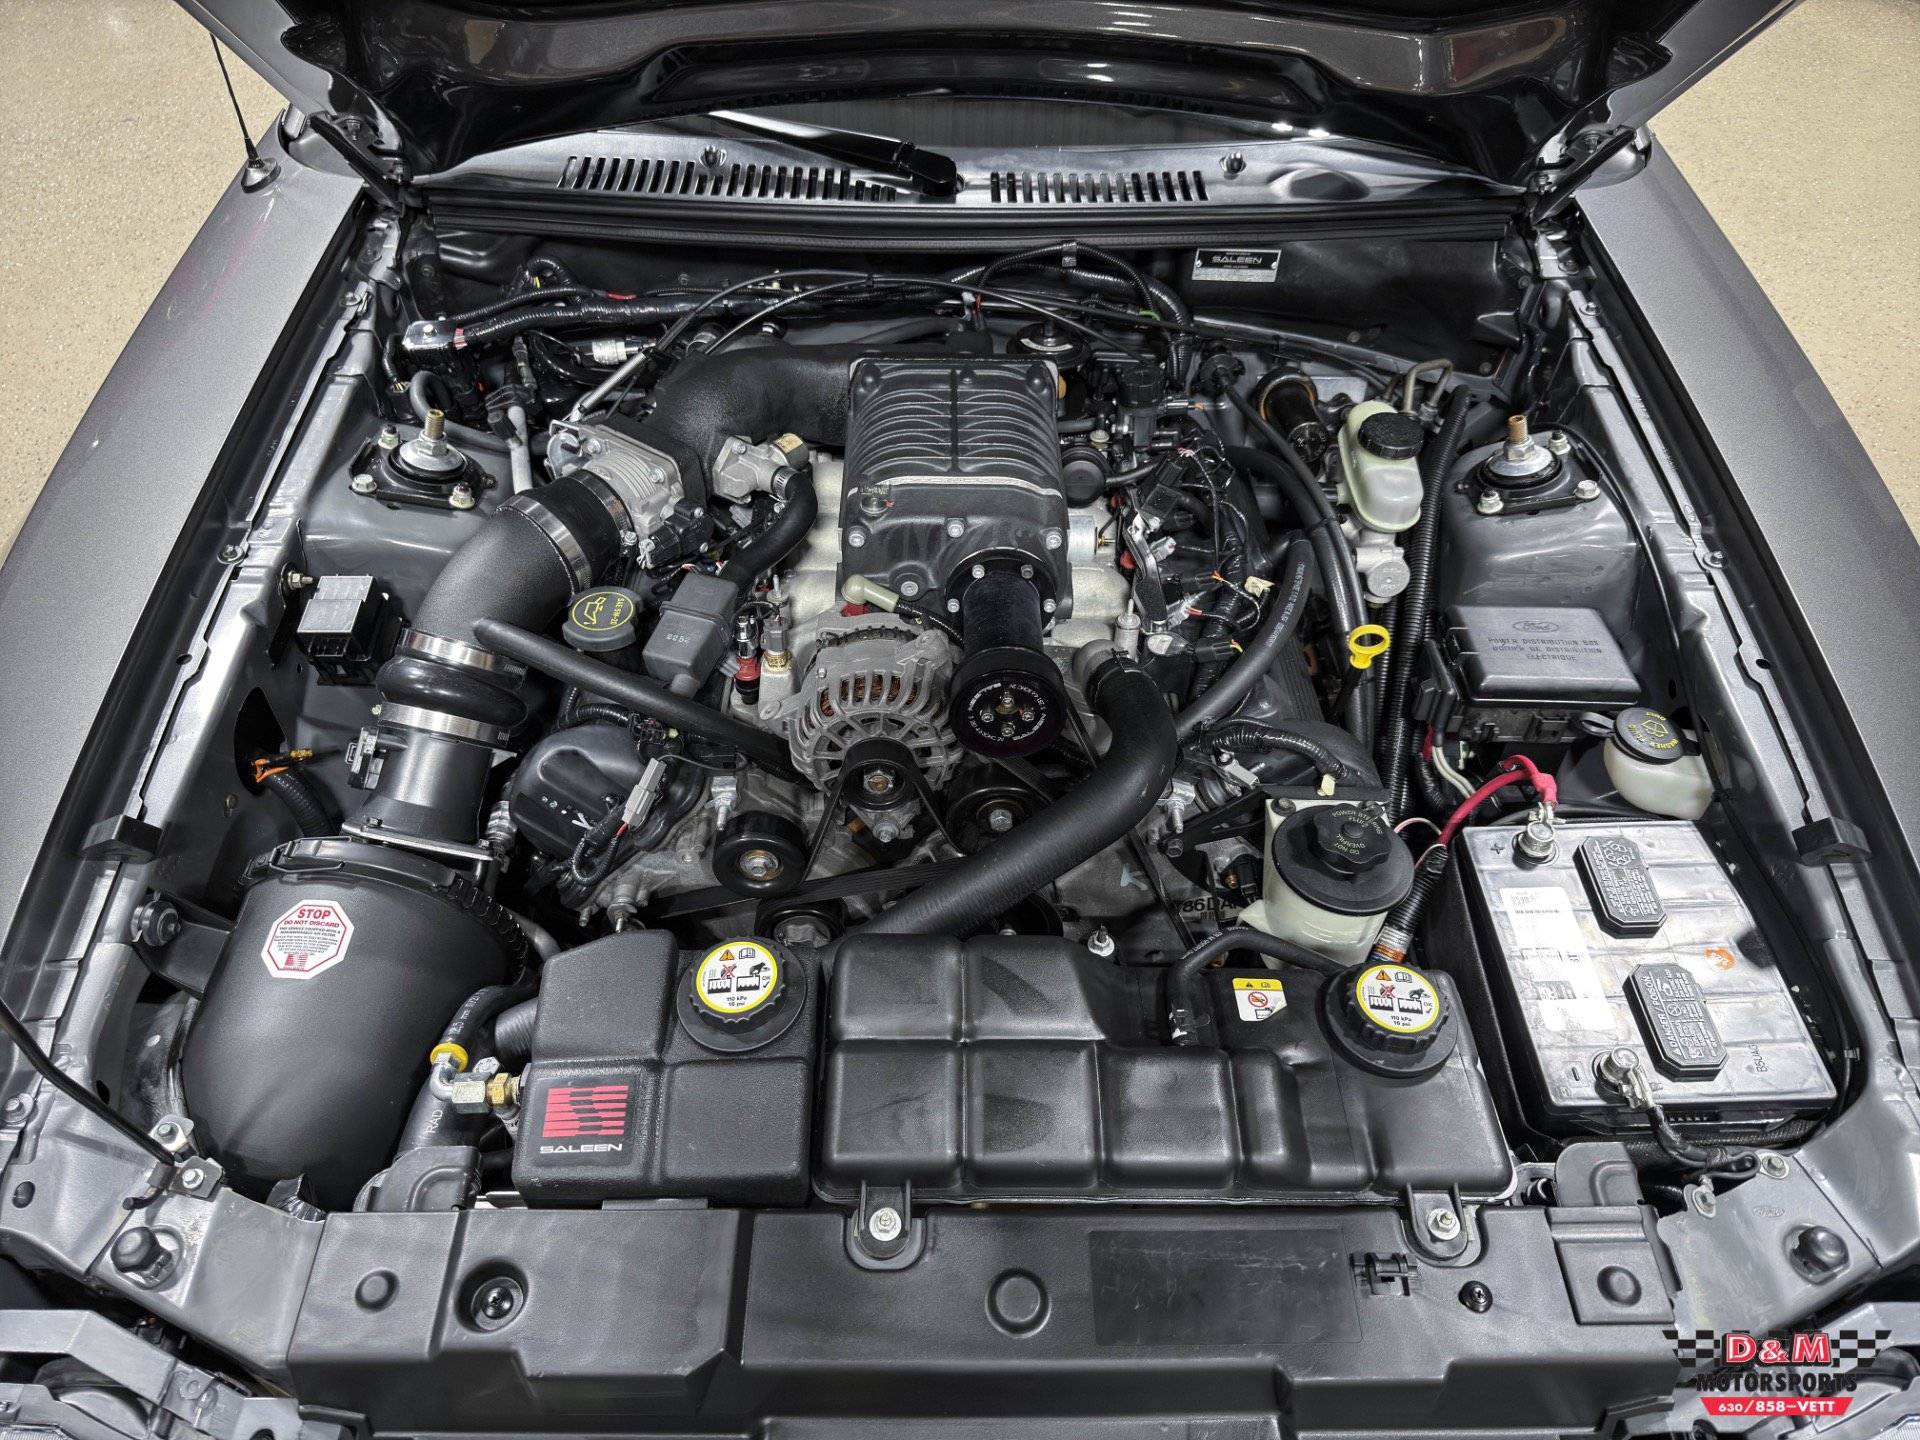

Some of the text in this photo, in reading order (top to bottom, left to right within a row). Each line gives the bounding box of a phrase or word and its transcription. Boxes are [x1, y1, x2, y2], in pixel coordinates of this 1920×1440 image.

[1212, 256, 1262, 264] SALEEN
[1488, 637, 1518, 645] POWER
[1522, 638, 1578, 646] DISTRIBUTION
[1645, 711, 1667, 721] ONLY
[1628, 723, 1679, 750] WASHER FLUID
[1331, 809, 1357, 818] POWER
[1335, 833, 1367, 849] OVERFILL
[1333, 842, 1360, 856] DO NOT
[297, 908, 332, 920] STOP
[1641, 976, 1662, 1007] POISON
[1657, 1013, 1679, 1048] DANGER
[426, 1108, 444, 1134] RAD
[540, 1143, 623, 1154] SALEEN
